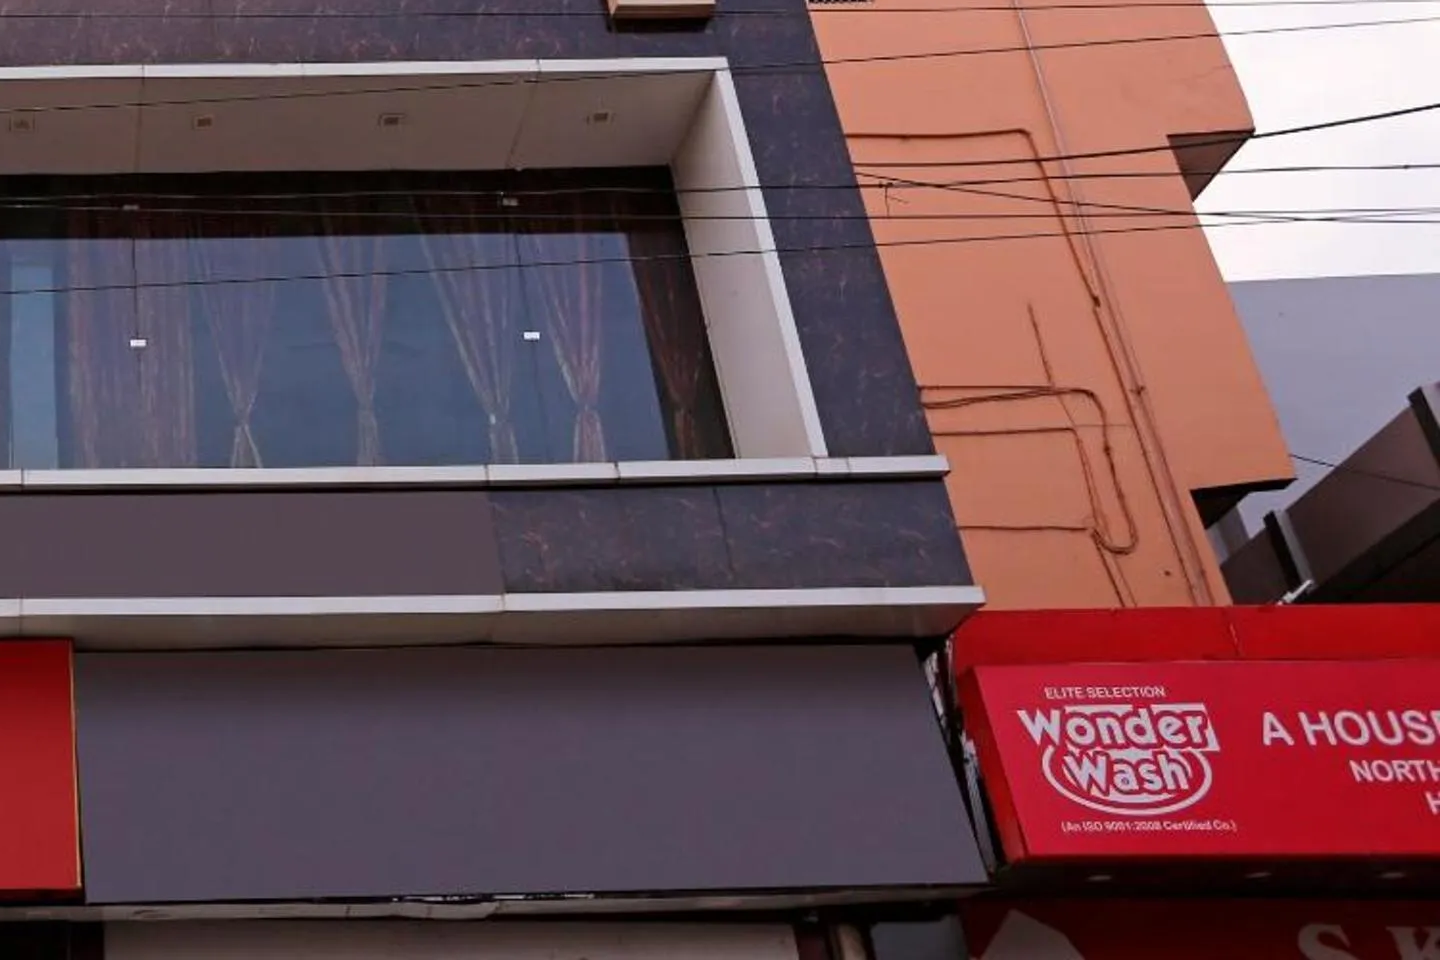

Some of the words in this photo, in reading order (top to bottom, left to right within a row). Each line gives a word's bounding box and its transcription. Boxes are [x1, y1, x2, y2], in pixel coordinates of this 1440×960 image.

[1045, 686, 1084, 699] ELITE
[1086, 685, 1168, 698] SELECTION
[1016, 706, 1204, 747] Wonder
[1263, 711, 1295, 746] A
[1063, 751, 1190, 793] Wash
